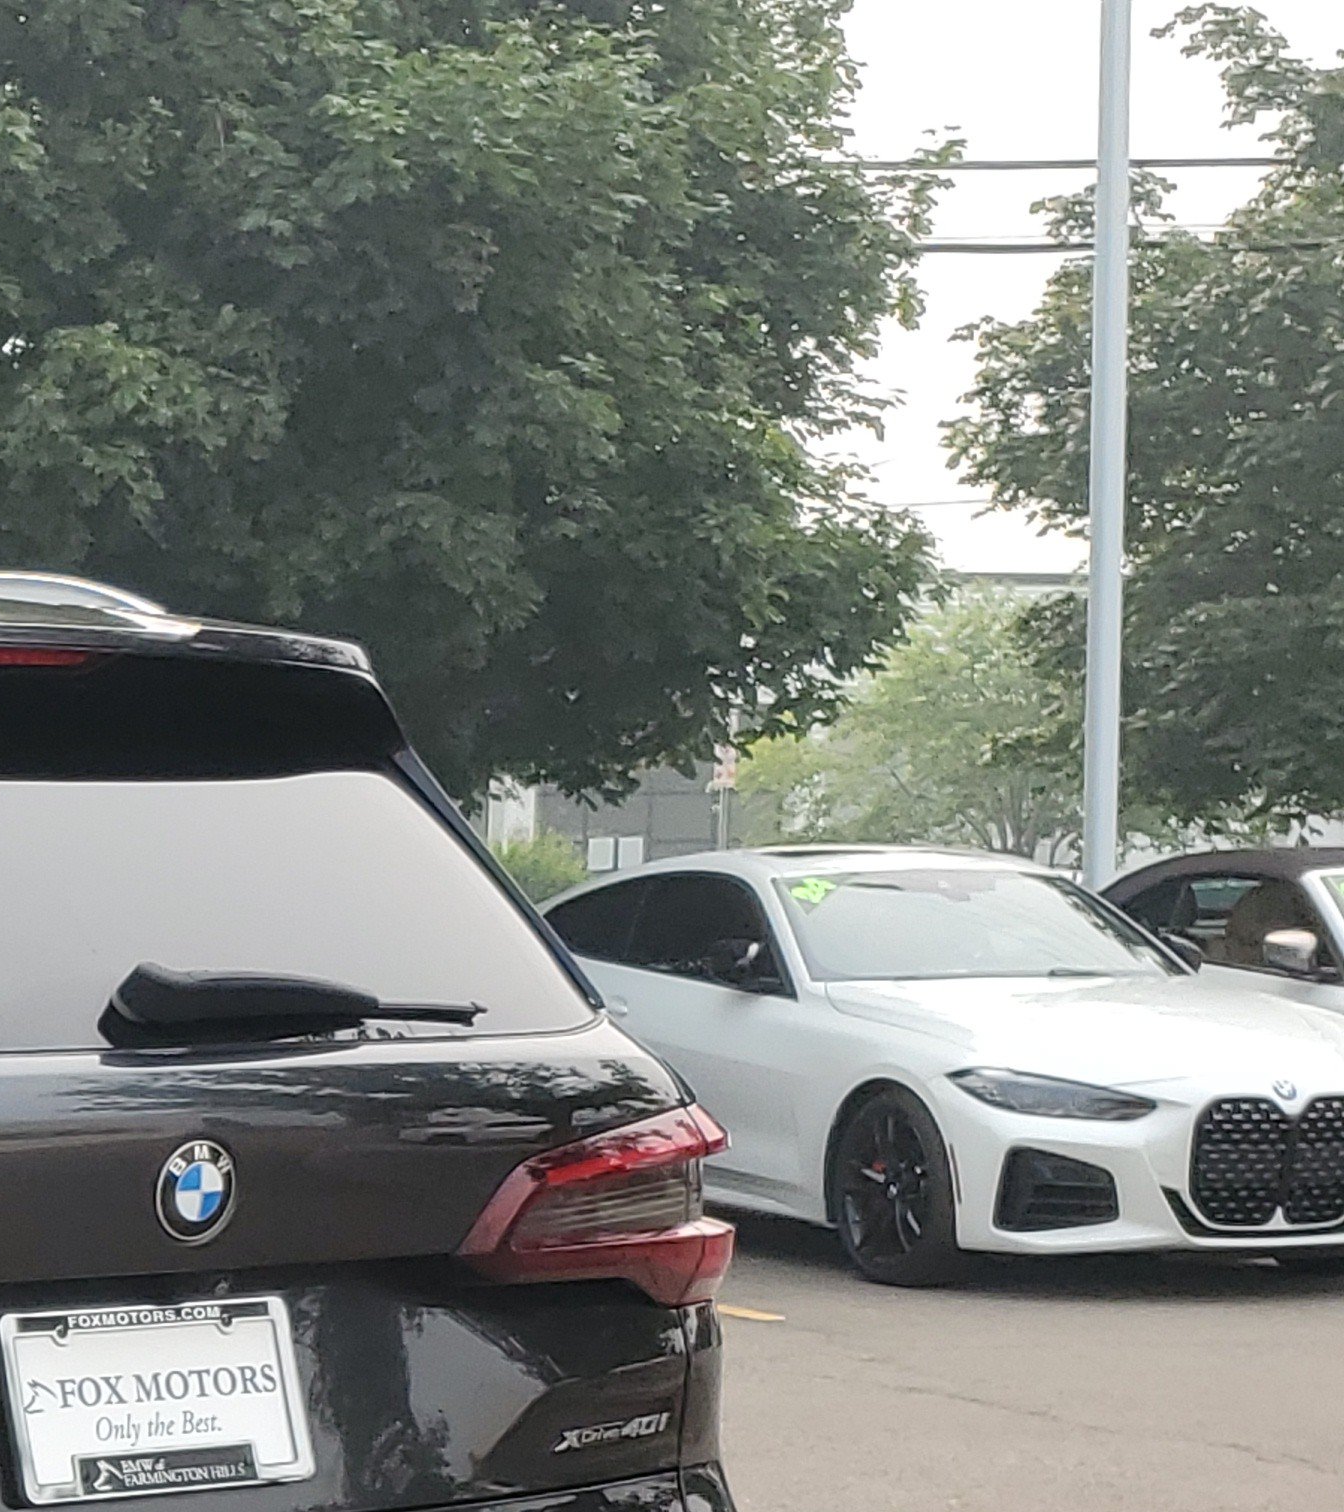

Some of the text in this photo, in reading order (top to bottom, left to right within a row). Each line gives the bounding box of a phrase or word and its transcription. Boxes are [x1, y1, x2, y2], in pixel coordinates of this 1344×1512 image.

[168, 1144, 232, 1177] BMW
[67, 1306, 222, 1329] FOXMOTORS.COM
[55, 1363, 277, 1409] FOX MOTORS
[95, 1409, 223, 1447] Only the Best.
[123, 1462, 246, 1487] FARMINGTON HILLS
